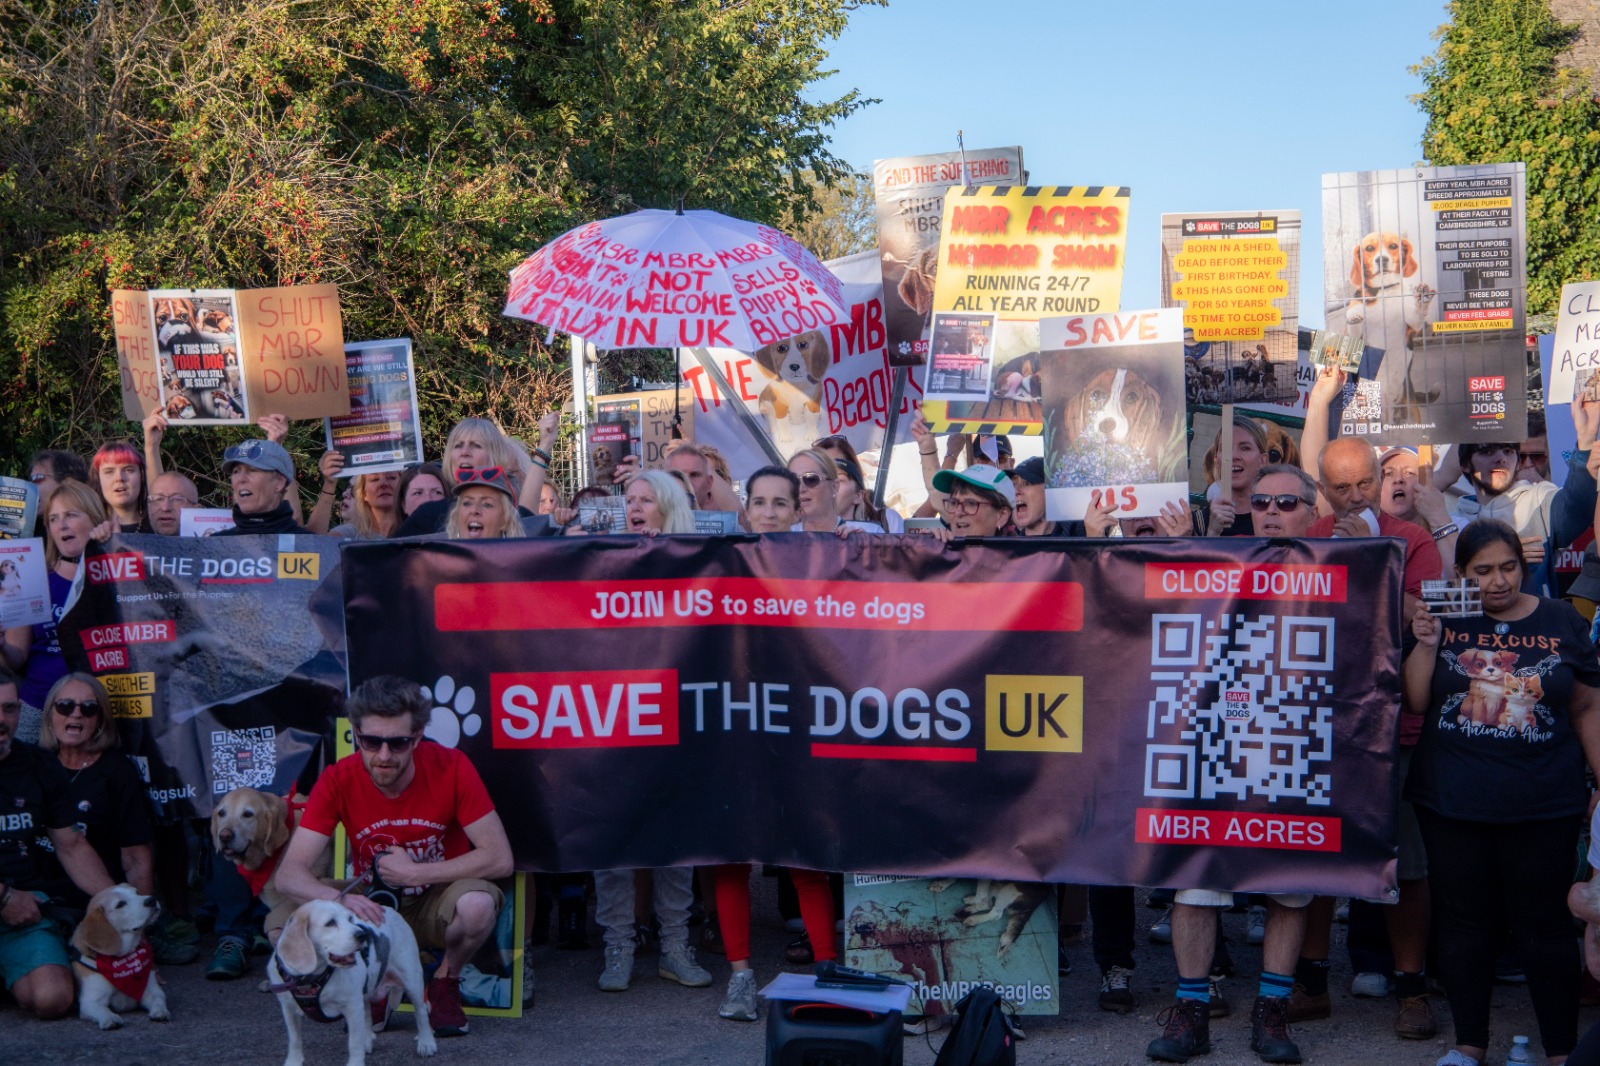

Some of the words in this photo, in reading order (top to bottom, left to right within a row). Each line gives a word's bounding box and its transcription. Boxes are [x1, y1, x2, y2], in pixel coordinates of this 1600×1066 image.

[886, 168, 911, 187] END
[913, 165, 938, 183] THE
[940, 158, 1009, 181] SUFERING
[1427, 192, 1452, 200] BREEDS
[1454, 189, 1509, 198] APPROXIMATELY
[949, 205, 1010, 236] MBR
[1026, 205, 1120, 238] ACRES
[1198, 222, 1219, 231] SAVE
[1220, 222, 1235, 230] THE
[1237, 221, 1260, 230] DOGS
[1262, 220, 1273, 229] UK
[1439, 220, 1498, 229] CAMBRIDGESHIRE,
[582, 235, 639, 265] MBR
[1187, 244, 1216, 253] BORN
[1219, 244, 1231, 253] IN
[1233, 243, 1241, 252] A
[1243, 243, 1274, 252] SHED.
[1439, 242, 1457, 250] THEIR
[1476, 240, 1509, 248] PURPOSE:
[1480, 250, 1498, 258] SOLD
[640, 251, 716, 269] MBR
[715, 243, 773, 269] MBR
[947, 244, 1038, 270] HORROR
[1051, 243, 1117, 271] SHOW
[1178, 258, 1206, 268] DEAD
[1209, 257, 1250, 267] BEFORE
[1252, 256, 1284, 266] THEIR
[1445, 261, 1494, 269] LABORATORIES
[649, 270, 714, 292] NOT
[731, 261, 800, 295] SELLS
[1188, 272, 1216, 281] FIRST
[1218, 271, 1273, 281] BIRTHDAY.
[1481, 270, 1509, 278] TESTING
[965, 275, 1040, 292] RUNNING
[1046, 276, 1090, 292] 24/7
[1176, 287, 1183, 295] &
[1186, 285, 1208, 295] THIS
[1211, 285, 1233, 294] HAS
[1236, 284, 1265, 294] GONE
[1268, 284, 1283, 293] ON
[626, 285, 737, 316] WELCOME
[739, 282, 801, 320] PUPPY
[952, 296, 984, 311] ALL
[989, 296, 1038, 312] YEAR
[1043, 296, 1100, 313] ROUND
[1192, 300, 1212, 309] FOR
[1215, 300, 1228, 308] 50
[1230, 299, 1267, 308] YEARS!
[1469, 301, 1481, 309] SEE
[113, 300, 148, 329] SAVE
[257, 295, 332, 328] SHUT
[521, 291, 614, 340] ITALY
[1199, 314, 1225, 323] TIME
[1228, 313, 1241, 322] TO
[1243, 312, 1276, 322] CLOSE
[749, 299, 837, 345] BLOOD
[830, 298, 887, 364] MB
[1063, 313, 1160, 347] SAVE
[614, 317, 659, 347] IN
[679, 318, 735, 347] UK
[1198, 328, 1221, 337] MBR
[1223, 327, 1260, 336] ACRES!
[118, 335, 150, 360] THE
[173, 344, 182, 354] IF
[182, 344, 200, 354] THIS
[200, 343, 220, 354] WAS
[259, 329, 324, 363] MBR
[172, 355, 203, 370] YOUR
[203, 354, 225, 370] DOG
[357, 365, 371, 373] ARE
[387, 362, 408, 370] STILL
[177, 370, 197, 378] WOULD
[197, 370, 209, 378] YOU
[209, 370, 224, 378] STILL
[185, 379, 194, 387] BE
[195, 378, 220, 388] SILENT?
[263, 366, 340, 395] DOWN
[378, 371, 407, 383] DOGS
[122, 367, 160, 401] DOGS
[1470, 378, 1502, 389] SAVE
[1470, 392, 1491, 402] THE
[1471, 402, 1506, 414] DOGS
[88, 556, 140, 581] SAVE
[143, 555, 193, 576] THE
[201, 556, 273, 578] DOGS
[283, 557, 314, 576] UK
[1162, 569, 1241, 593] CLOSE
[1252, 570, 1332, 596] DOWN
[116, 594, 152, 603] Support
[153, 592, 164, 600] Us
[168, 592, 180, 600] For
[182, 590, 197, 599] the
[199, 590, 234, 600] Puppies
[591, 590, 664, 619] JOIN
[673, 589, 713, 616] US
[721, 595, 748, 615] to
[752, 597, 808, 616] save
[814, 594, 856, 617] the
[863, 596, 925, 624] dogs
[91, 627, 122, 645] CLOSE
[123, 624, 168, 642] MBR
[1477, 633, 1561, 656] EXCUSE
[95, 650, 124, 669] ACRES
[1226, 692, 1249, 701] SAVE
[501, 682, 663, 740] SAVE
[681, 681, 790, 734] THE
[809, 686, 972, 741] DOGS
[999, 692, 1070, 739] UK
[1226, 709, 1250, 718] DOGS
[1460, 719, 1516, 738] Animal
[371, 819, 389, 829] THE
[1148, 815, 1210, 840] MBR
[1224, 817, 1325, 845] ACRES
[911, 980, 1052, 1006] TheMBeagles
